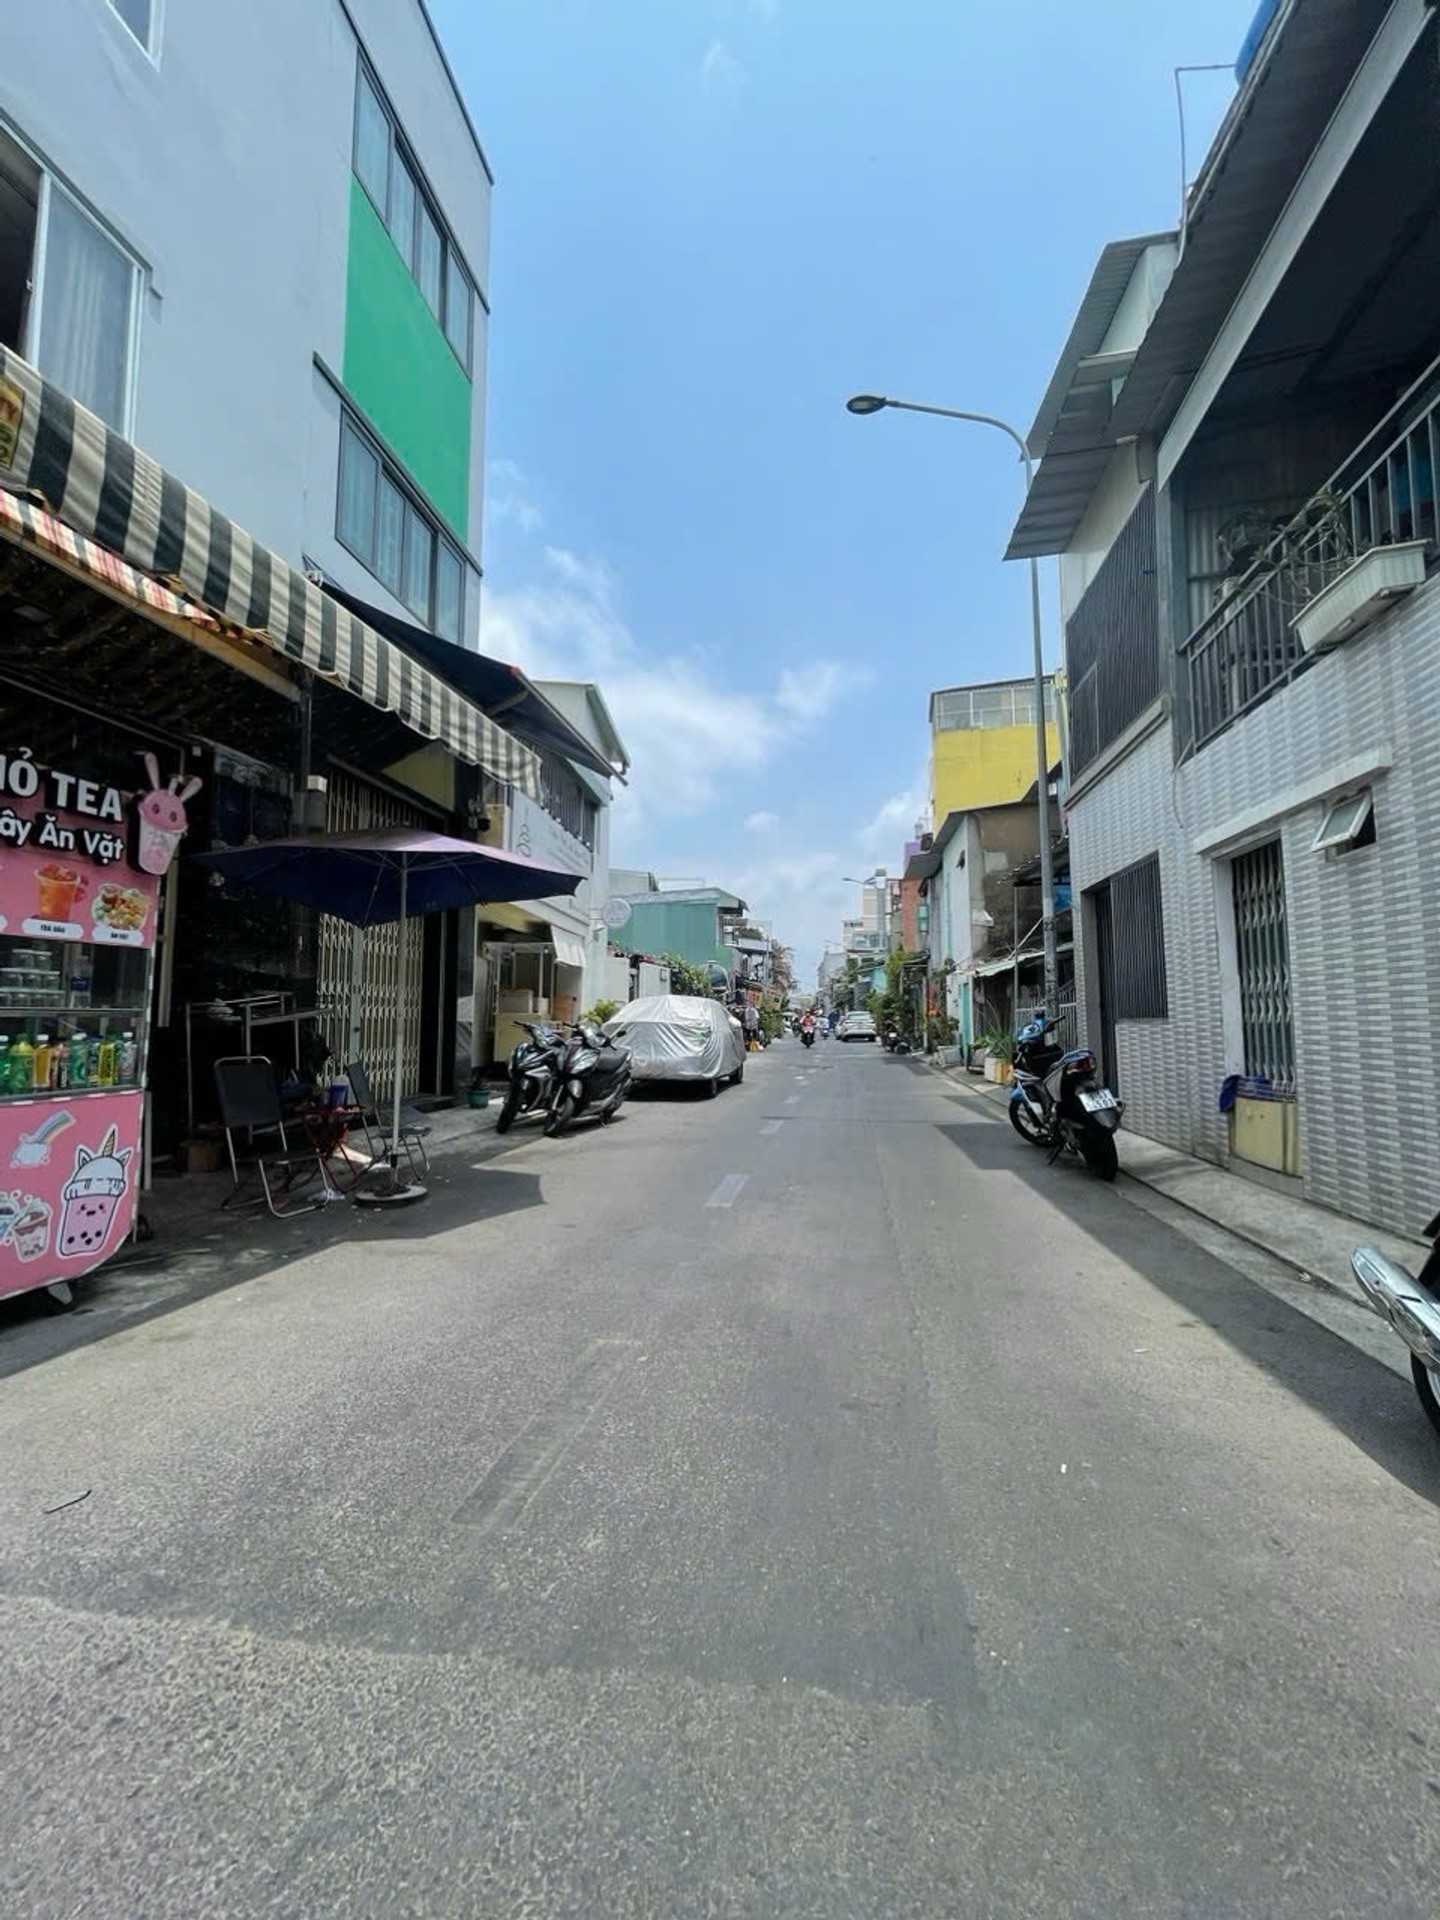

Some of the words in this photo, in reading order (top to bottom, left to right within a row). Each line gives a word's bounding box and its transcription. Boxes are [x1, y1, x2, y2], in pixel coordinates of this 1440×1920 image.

[51, 771, 123, 821] TEA
[39, 815, 74, 850] Ăn
[83, 830, 124, 864] Vặt
